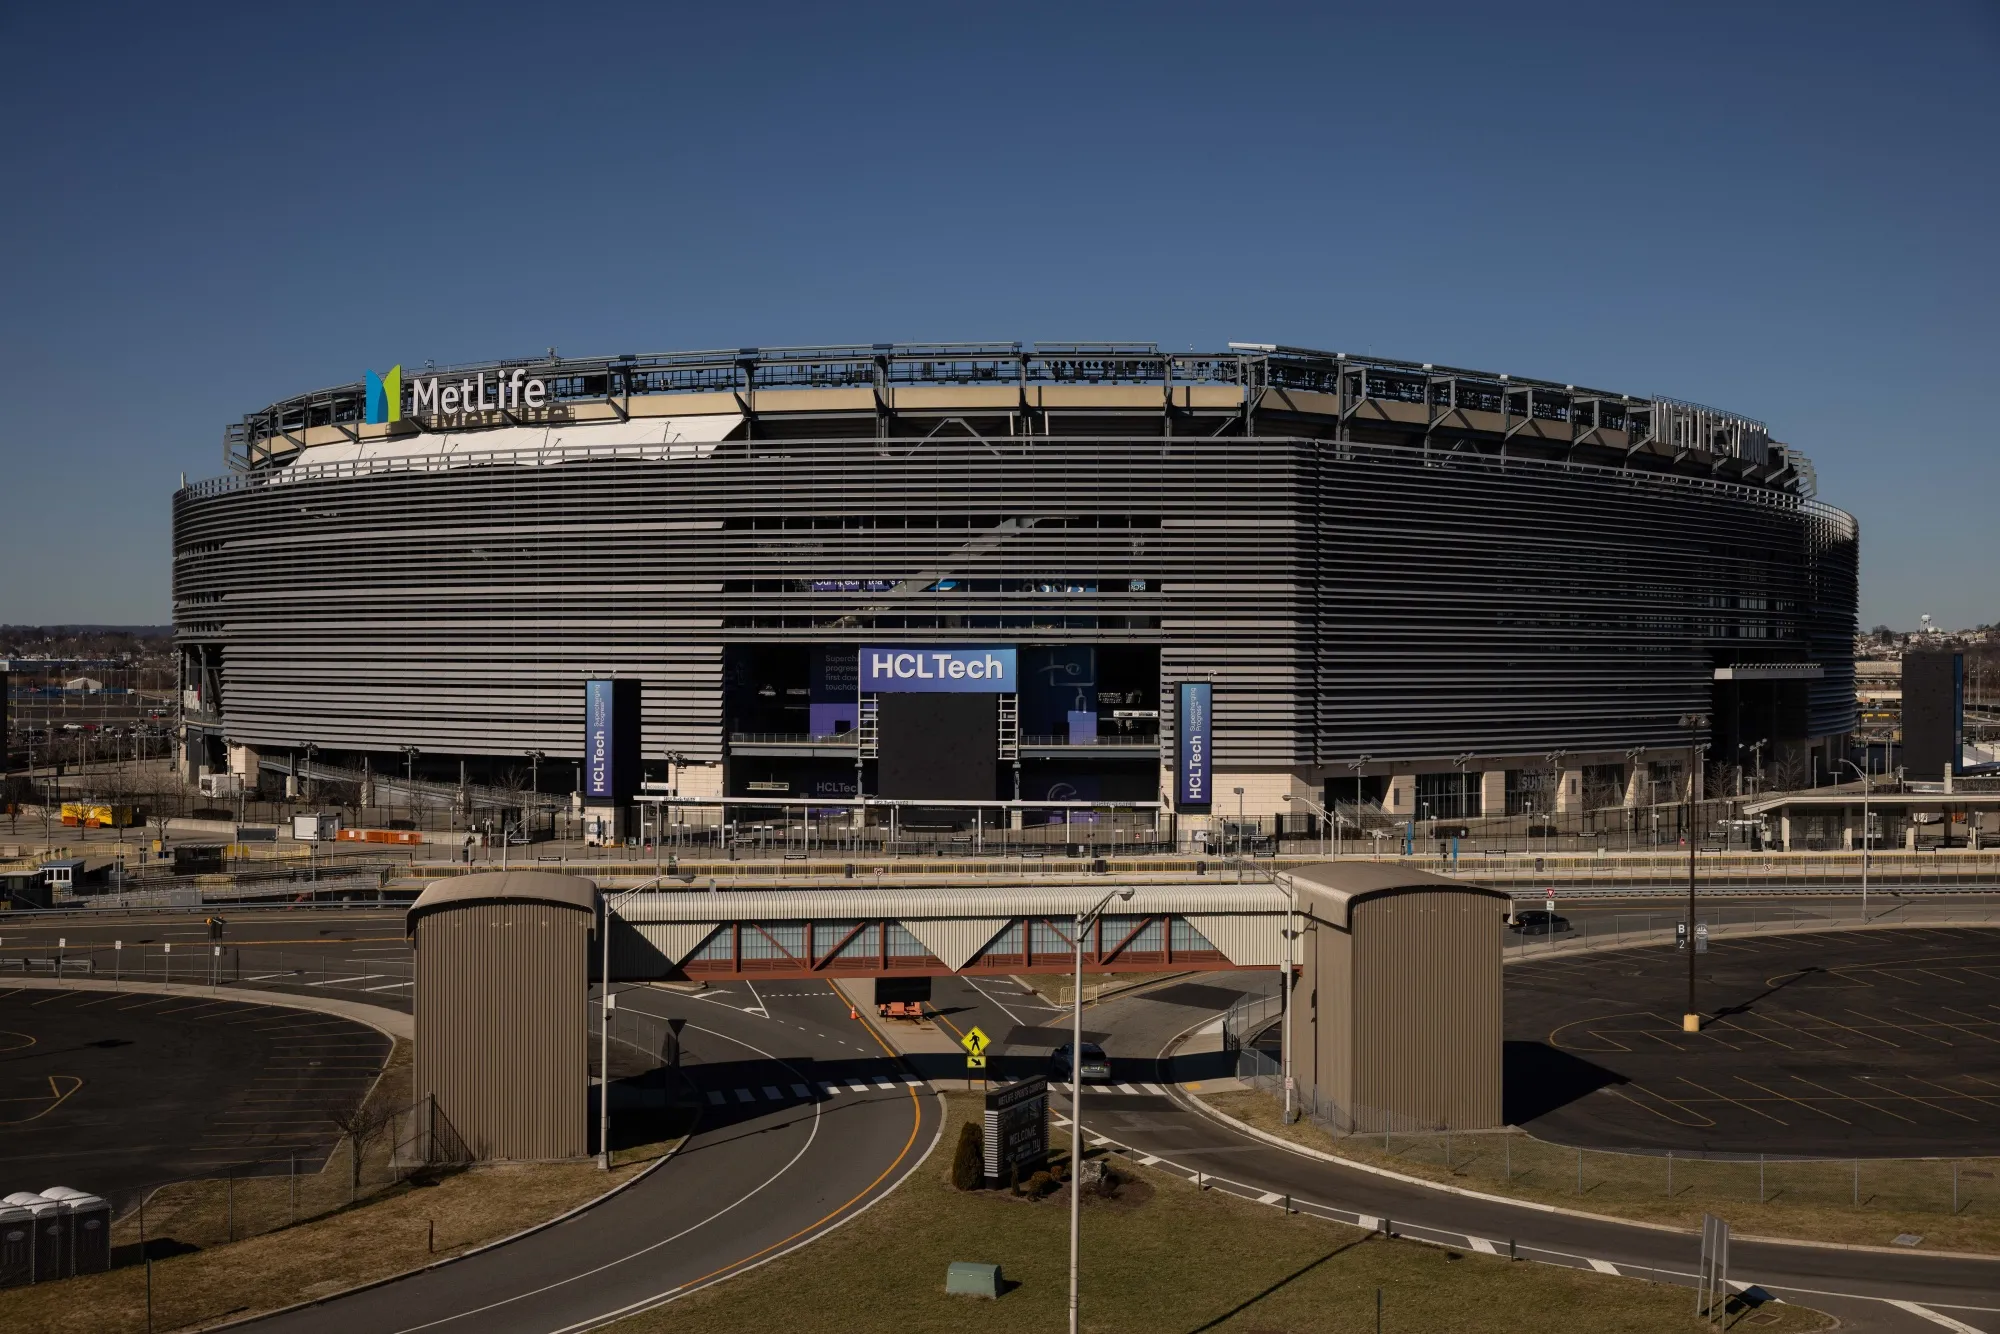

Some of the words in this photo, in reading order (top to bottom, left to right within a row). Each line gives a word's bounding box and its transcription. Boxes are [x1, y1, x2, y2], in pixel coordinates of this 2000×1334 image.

[413, 368, 547, 416] MetLife
[825, 655, 858, 664] Superch
[872, 653, 1004, 679] HCLTech
[825, 673, 841, 681] first
[825, 683, 858, 691] touchdo
[1189, 687, 1197, 732] Supercharging
[593, 731, 605, 792] HCLTech
[1189, 735, 1202, 799] HCLTech
[816, 782, 857, 792] HCLTec
[1678, 924, 1685, 934] B
[1679, 939, 1685, 949] 2
[1009, 1124, 1037, 1147] WELCOME
